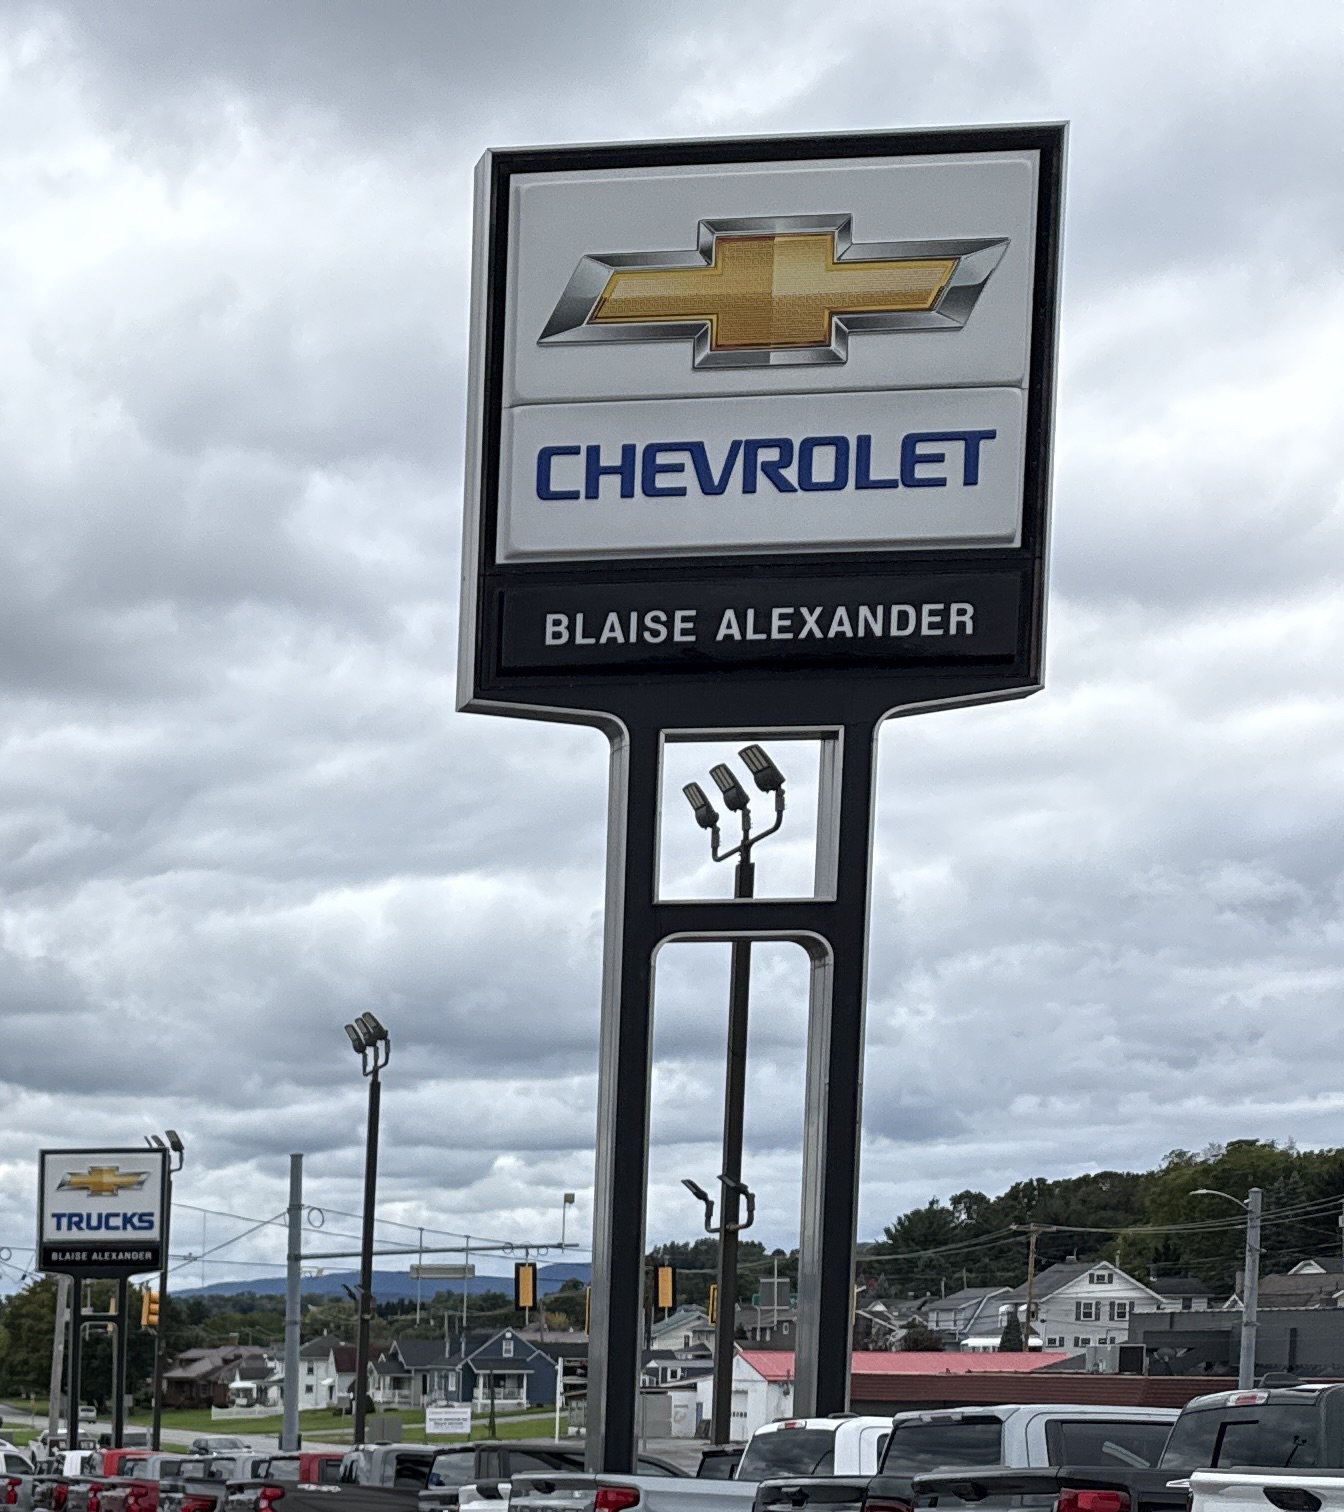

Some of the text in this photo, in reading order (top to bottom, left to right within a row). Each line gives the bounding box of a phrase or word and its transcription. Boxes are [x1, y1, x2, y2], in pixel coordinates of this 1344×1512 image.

[536, 429, 997, 502] CHEVROLET
[545, 602, 975, 646] BLAISE ALEXANDER
[51, 1212, 154, 1231] TRUCKS
[52, 1251, 152, 1261] BLAISE ALEXANDER
